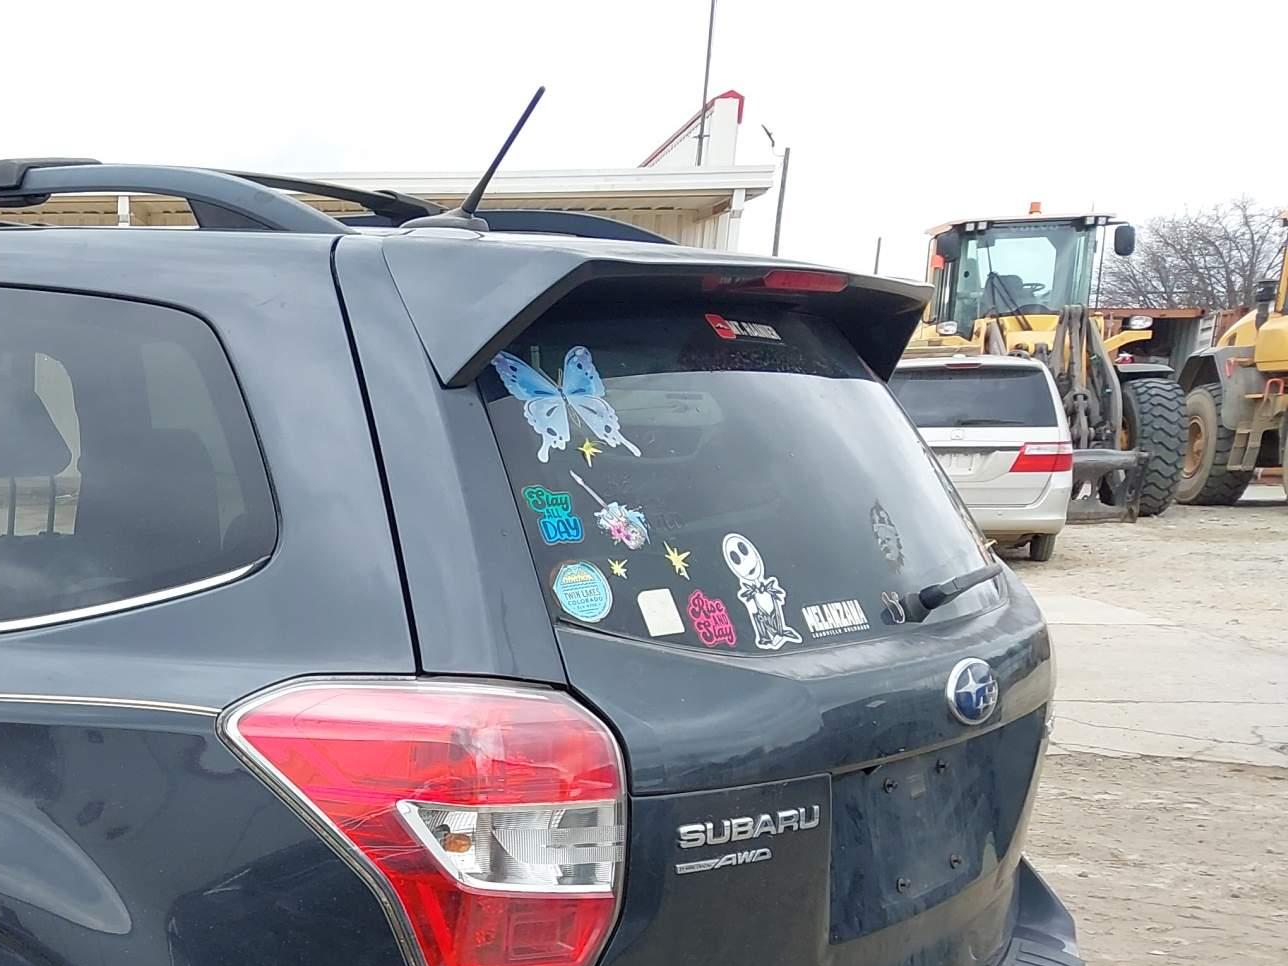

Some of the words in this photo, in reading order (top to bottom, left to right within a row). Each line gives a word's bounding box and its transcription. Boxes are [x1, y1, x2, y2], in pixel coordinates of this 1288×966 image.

[527, 489, 569, 512] Slay
[545, 508, 563, 519] ALL
[541, 518, 580, 540] DAY
[567, 596, 604, 606] COLORADO
[690, 593, 724, 619] Rise
[711, 613, 729, 626] AND
[802, 599, 869, 633] MELANZANA
[696, 620, 734, 643] Slay
[678, 804, 820, 849] SUBARU
[714, 848, 773, 869] AWD
